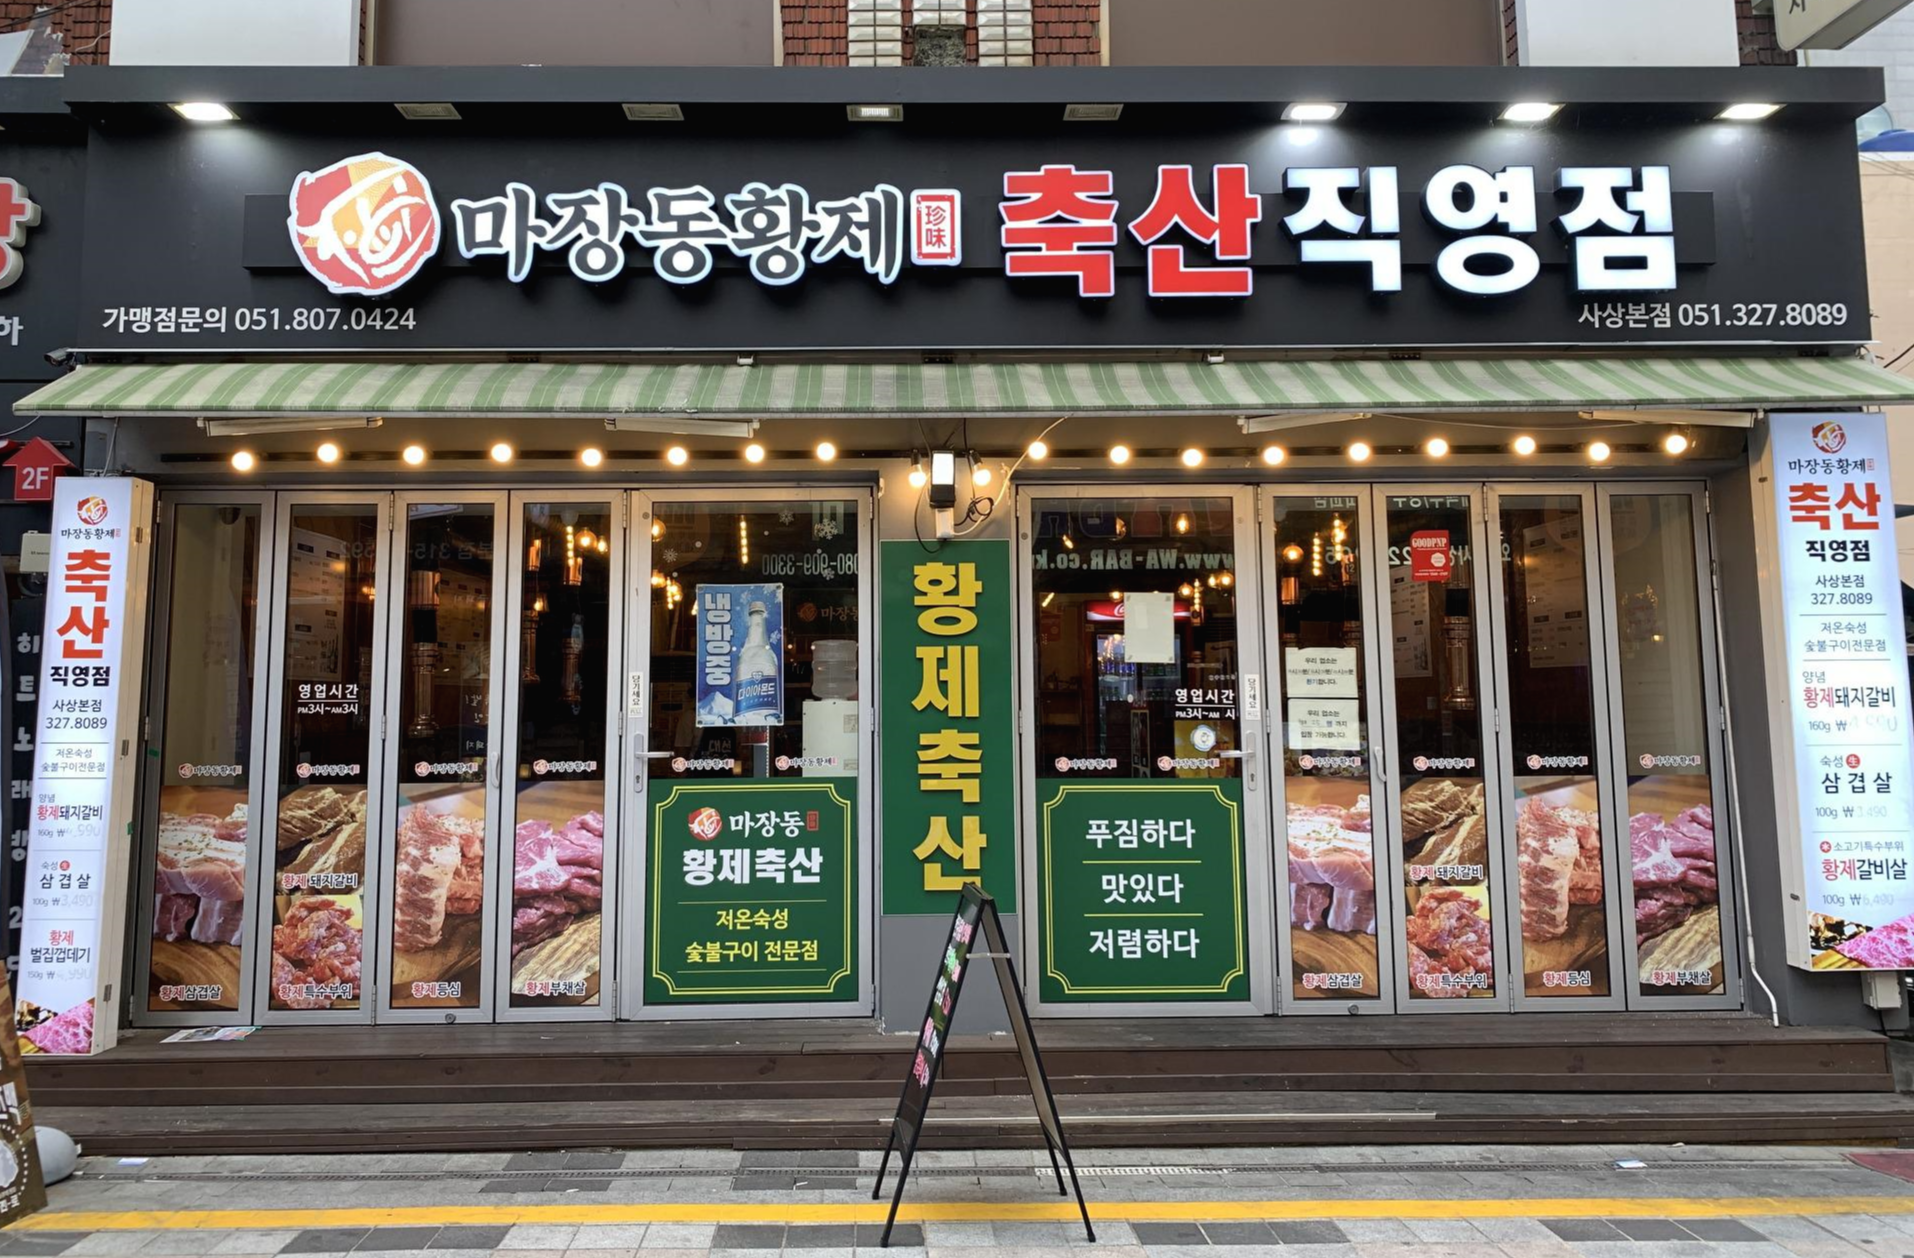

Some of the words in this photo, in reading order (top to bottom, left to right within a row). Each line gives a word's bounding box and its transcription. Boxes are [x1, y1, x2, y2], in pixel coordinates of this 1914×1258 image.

[450, 181, 903, 284] 마장동황제
[998, 164, 1262, 297] 축산
[1283, 163, 1678, 295] 직영점
[102, 307, 226, 334] 가맹점문의
[234, 308, 416, 331] 051.807.0424
[1578, 302, 1672, 328] 사상본점
[1678, 303, 1847, 326] 051.327.8089
[1788, 458, 1866, 475] 마장동황제
[22, 466, 49, 490] 2F
[1788, 482, 1881, 530] 축산
[61, 527, 115, 540] 마장동황제
[1805, 540, 1871, 562] 직영점
[1815, 574, 1865, 589] 사상본점
[56, 549, 111, 659] 축산
[1811, 592, 1873, 605] 327.8089
[1820, 622, 1867, 635] 저온숙성
[1804, 638, 1887, 652] 숯불구이전문점
[50, 666, 111, 687] 직영점
[1802, 670, 1826, 684] 양념
[298, 683, 359, 700] 영업시간
[632, 675, 640, 706] 당기세요
[737, 682, 775, 700] 다이아몬드
[1175, 688, 1236, 704] 영업시간
[1803, 687, 1896, 708] 황제돼지갈비
[52, 698, 102, 713] 사상본점
[45, 717, 107, 730] 327.8089
[911, 562, 988, 892] 황제축산
[1808, 720, 1831, 733] 160g
[56, 747, 92, 759] 저온숙성
[41, 761, 105, 773] 숯불구이전문점
[1820, 755, 1844, 768] 숙성
[36, 804, 103, 821] 황제돼지갈비
[1815, 807, 1838, 819] 100g
[730, 810, 805, 838] 마장동
[1085, 819, 1196, 848] 푸짐하다
[1834, 841, 1904, 852] 소고기특수부위
[41, 861, 58, 871] 숙성
[683, 847, 823, 886] 황제축산
[1411, 866, 1435, 880] 황제
[1437, 865, 1483, 880] 돼지갈비
[1821, 859, 1907, 881] 황제갈비살
[282, 874, 307, 888] 황제
[310, 873, 358, 888] 돼지갈비
[1101, 873, 1184, 903] 맛있다
[1822, 894, 1845, 906] 100g
[716, 908, 789, 930] 저온숙성
[49, 930, 74, 946] 황제
[1089, 928, 1200, 959] 저렴하다
[30, 948, 90, 964] 벌집껍데기
[685, 941, 758, 962] 숯불구이
[764, 940, 818, 961] 전문점
[1303, 973, 1362, 988] 황제삼겹살
[1417, 974, 1488, 988] 황제특수부위
[1543, 971, 1591, 986] 황제등심
[1652, 970, 1711, 986] 황제부채살
[160, 985, 221, 1000] 황제삼겹살
[279, 984, 352, 999] 황제특수부위
[412, 982, 461, 997] 황제등심
[526, 980, 586, 996] 황제부채살
